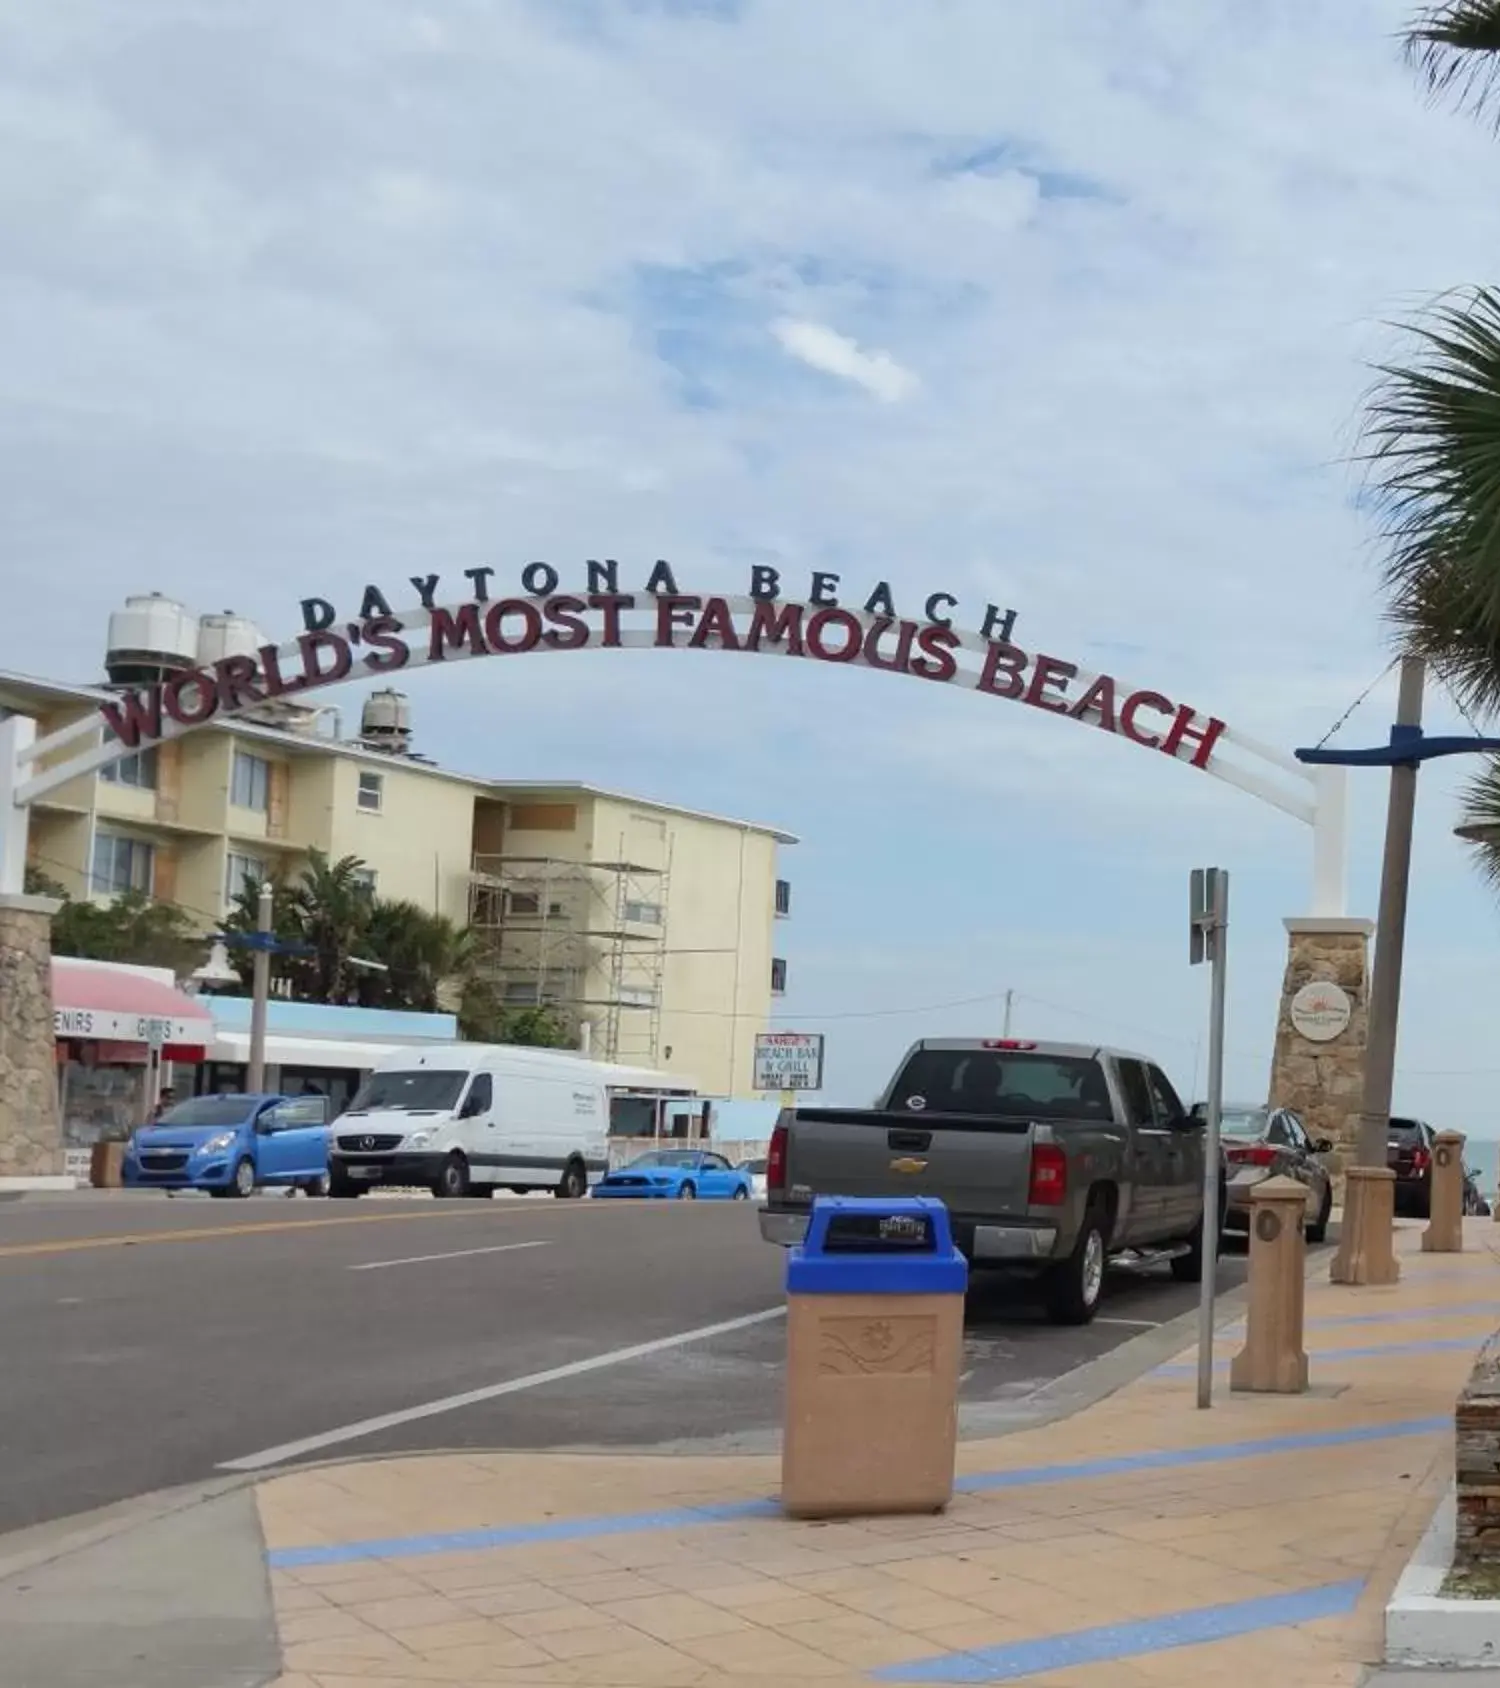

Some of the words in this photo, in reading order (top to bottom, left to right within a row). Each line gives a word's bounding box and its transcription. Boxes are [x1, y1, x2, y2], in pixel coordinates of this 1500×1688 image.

[300, 559, 679, 632] DAYTONA
[749, 565, 1019, 643] BEACH
[100, 614, 410, 748] WORLD'S
[427, 594, 635, 661] MOST
[654, 594, 961, 682] FAMOUS
[976, 638, 1226, 770] BEACH
